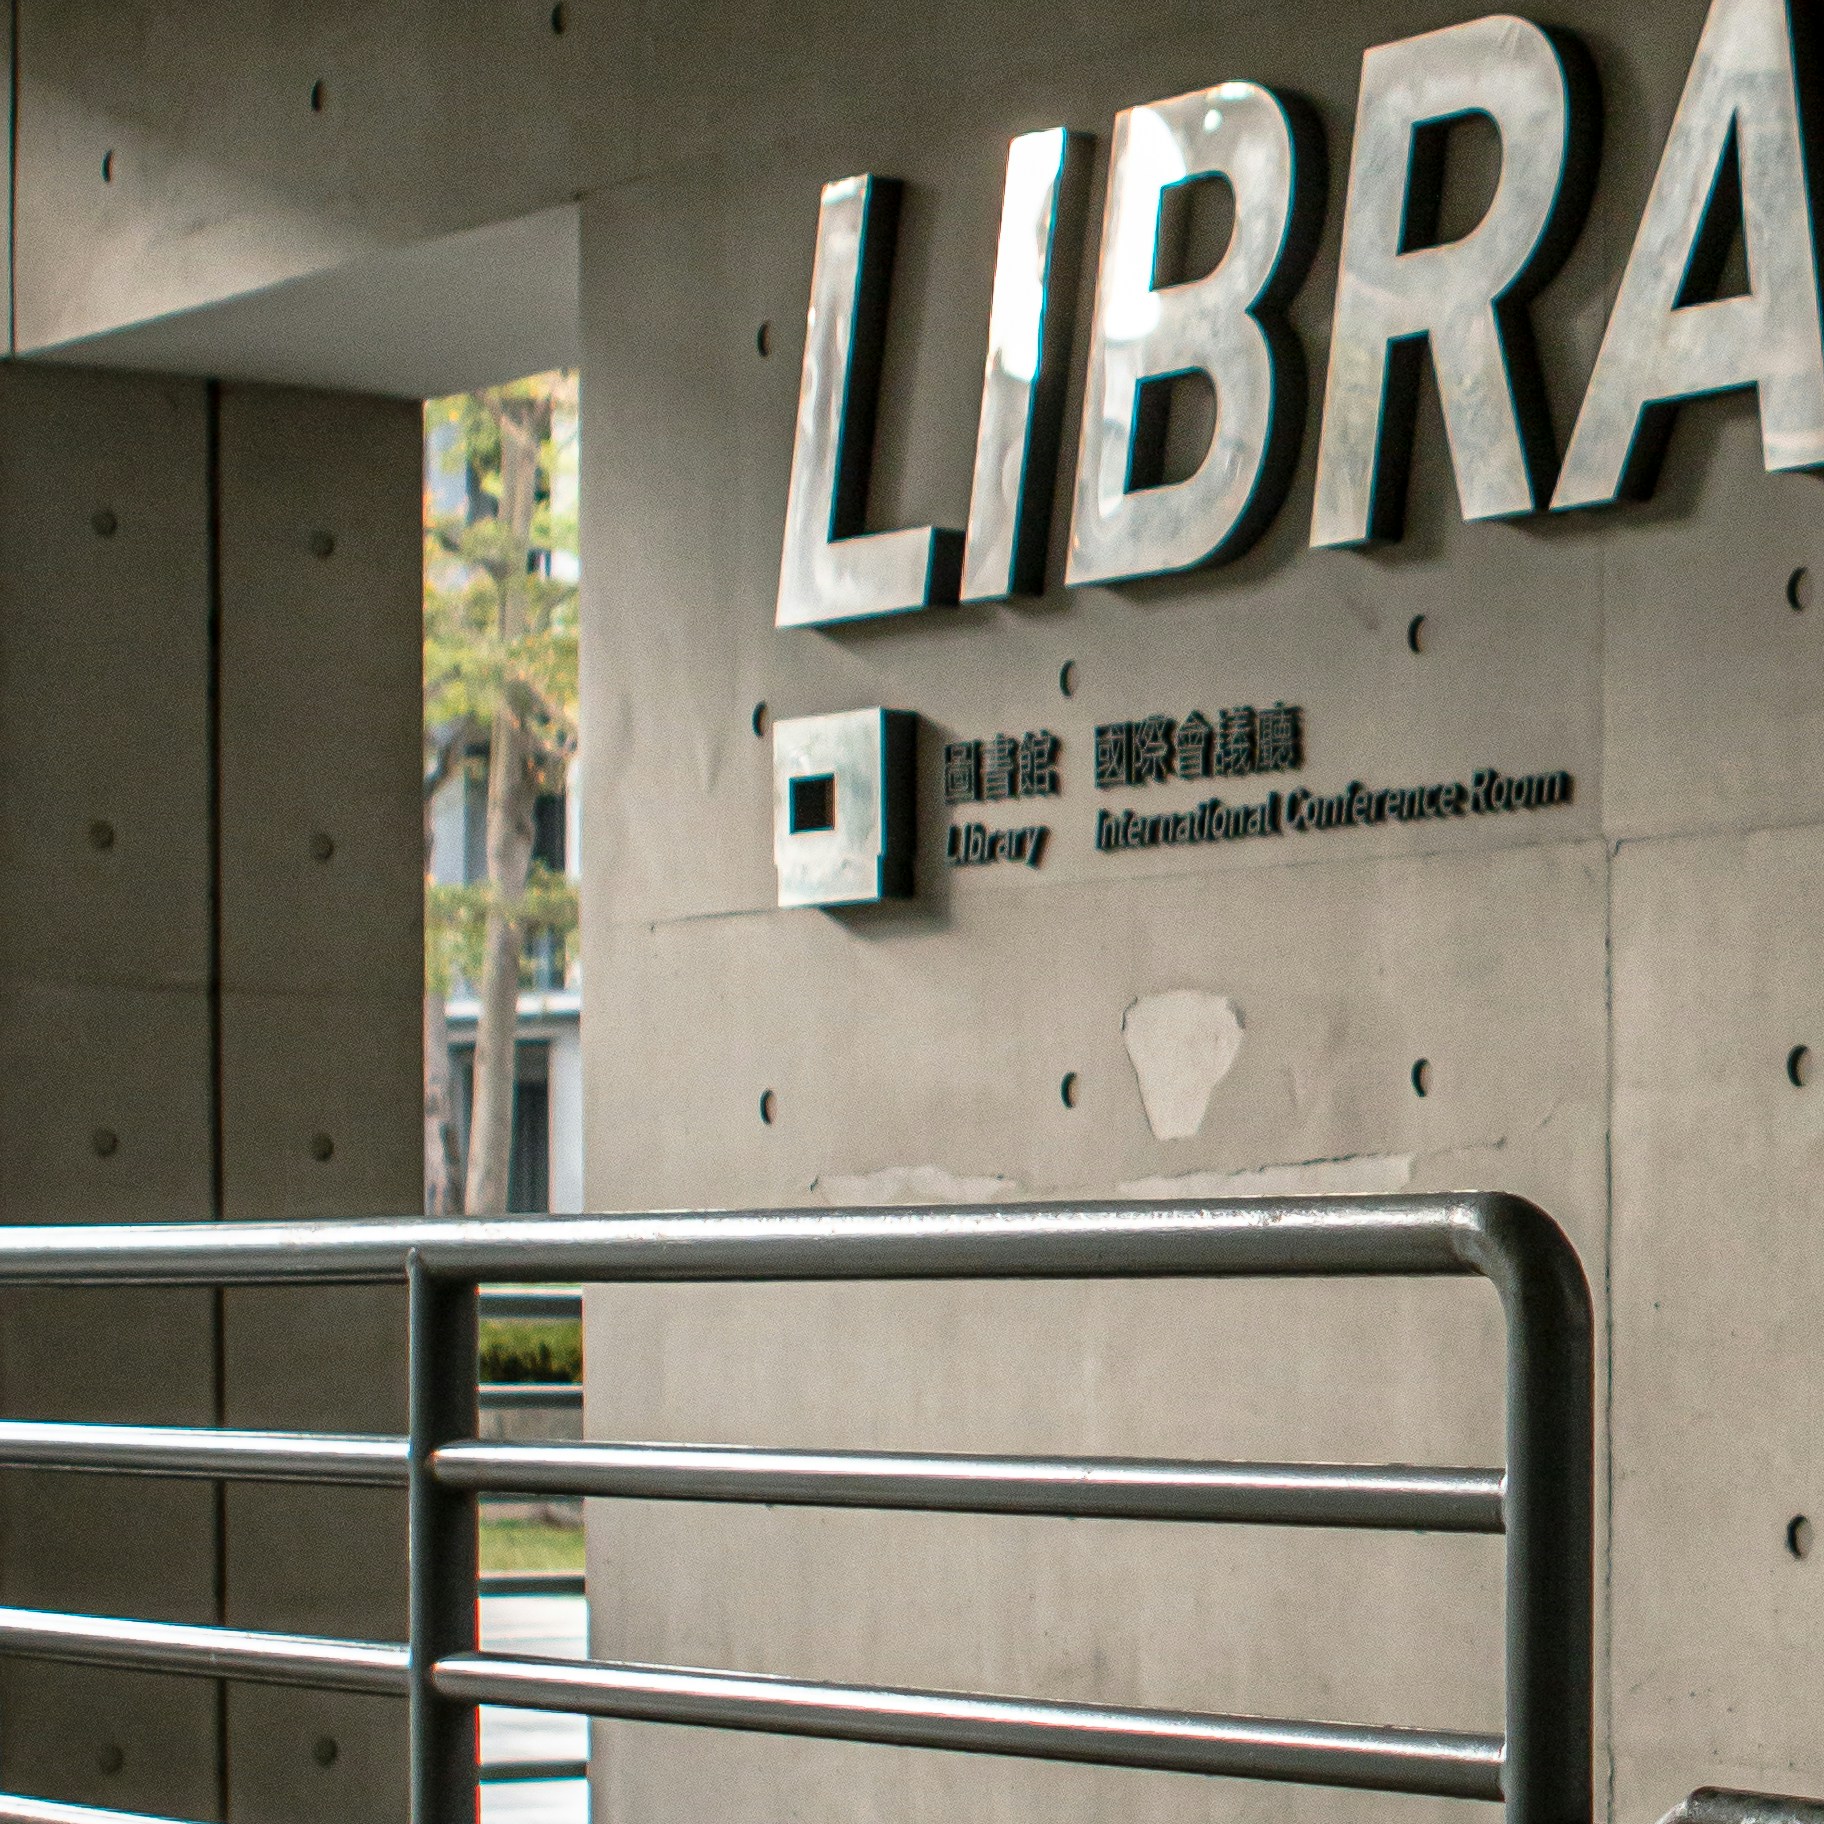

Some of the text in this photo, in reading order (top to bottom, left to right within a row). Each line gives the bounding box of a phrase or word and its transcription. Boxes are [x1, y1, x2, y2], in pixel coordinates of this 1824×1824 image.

[944, 729, 1062, 805] 圖書館
[1093, 702, 1306, 790] 國際會議廳
[945, 820, 1051, 870] Library
[1094, 766, 1577, 853] International Conference Room
